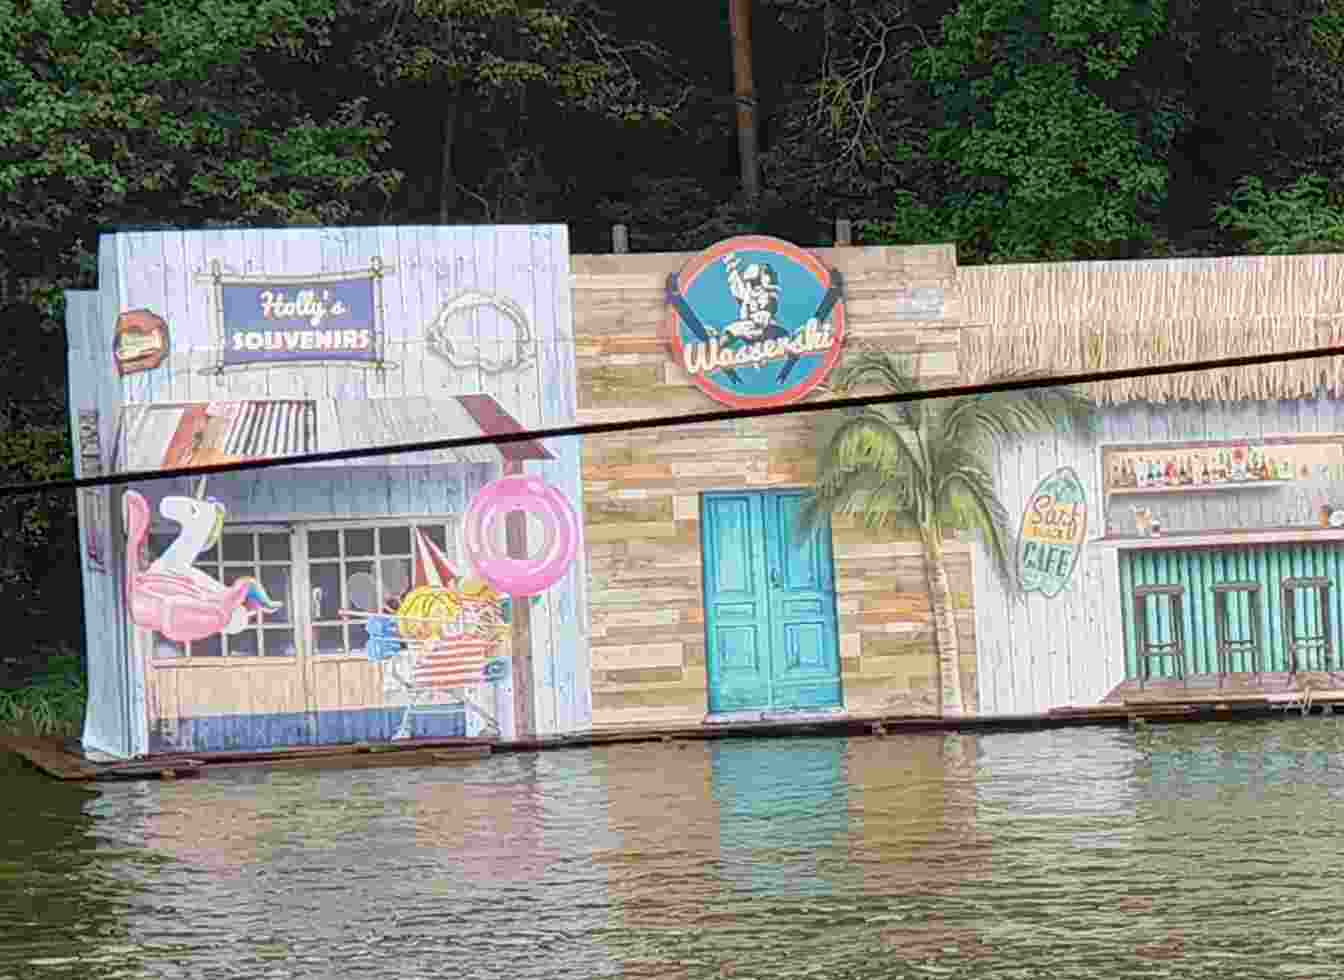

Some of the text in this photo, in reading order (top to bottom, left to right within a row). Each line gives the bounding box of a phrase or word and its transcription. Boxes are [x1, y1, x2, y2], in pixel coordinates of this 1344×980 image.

[261, 290, 346, 326] Holly's
[232, 330, 369, 352] SOUVENIRS
[684, 319, 834, 373] Wasserski
